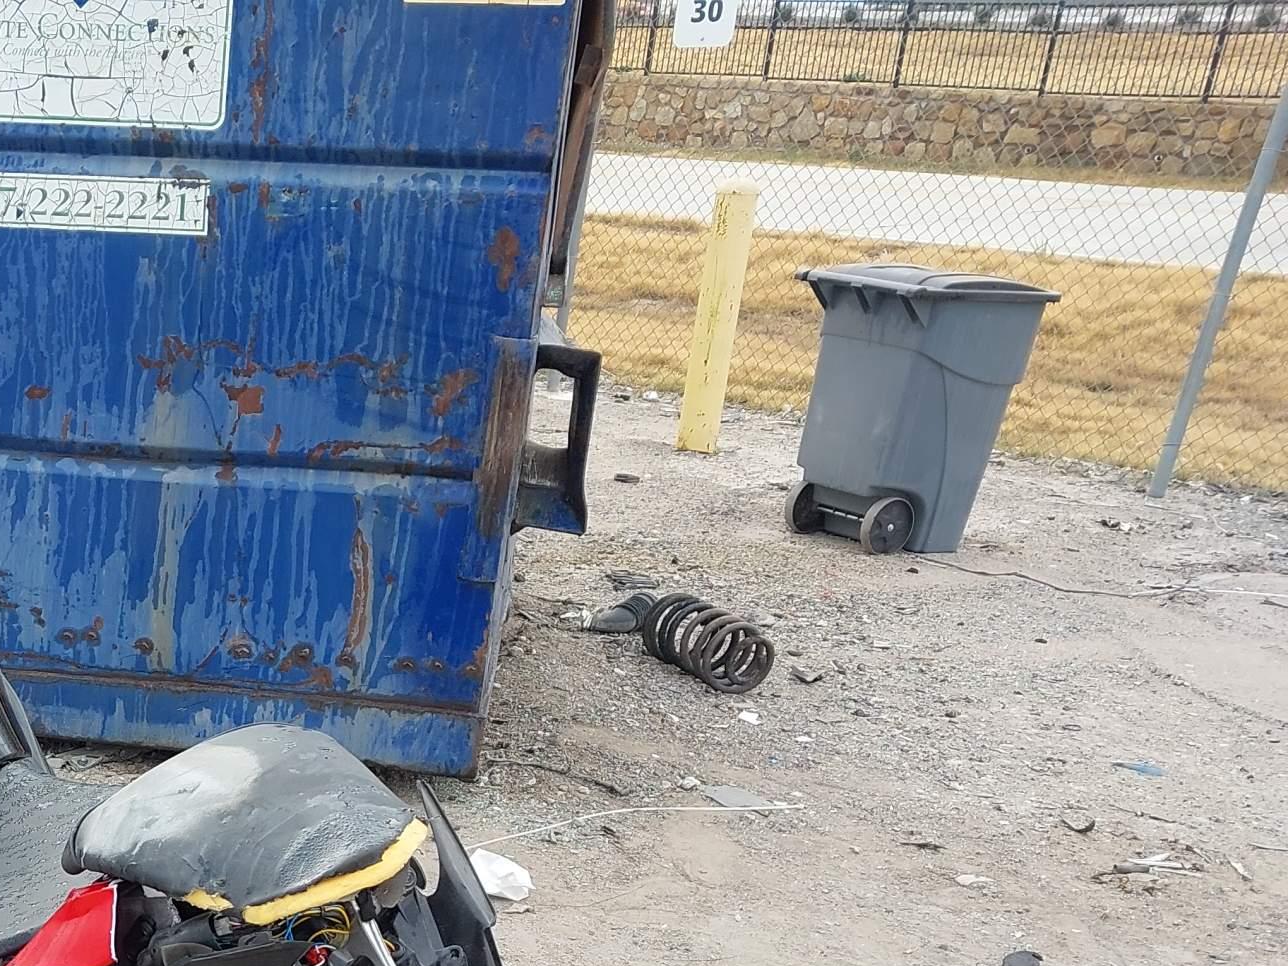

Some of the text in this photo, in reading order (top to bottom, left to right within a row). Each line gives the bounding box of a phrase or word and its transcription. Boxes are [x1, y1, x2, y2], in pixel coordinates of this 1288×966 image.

[691, 0, 724, 23] 30
[56, 44, 81, 58] with
[85, 45, 105, 58] the
